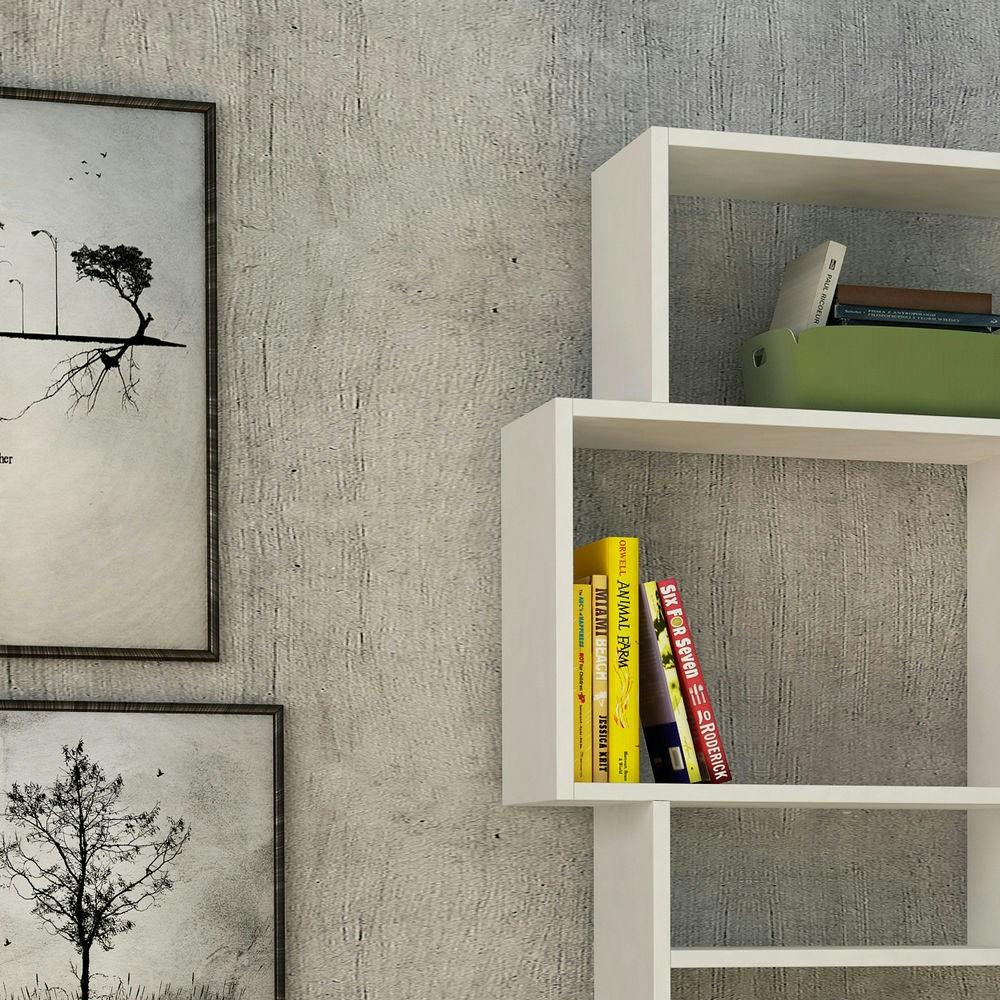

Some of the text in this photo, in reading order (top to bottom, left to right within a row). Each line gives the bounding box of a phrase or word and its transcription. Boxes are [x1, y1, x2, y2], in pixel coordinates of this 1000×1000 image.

[821, 274, 833, 293] PAUL
[812, 293, 828, 325] RICOEUR
[619, 540, 627, 577] ORWELL
[595, 588, 608, 681] MIAMI BEACH
[616, 580, 631, 669] ANIMAL FARM
[598, 715, 608, 749] JESSICA
[699, 723, 728, 781] RODERICK
